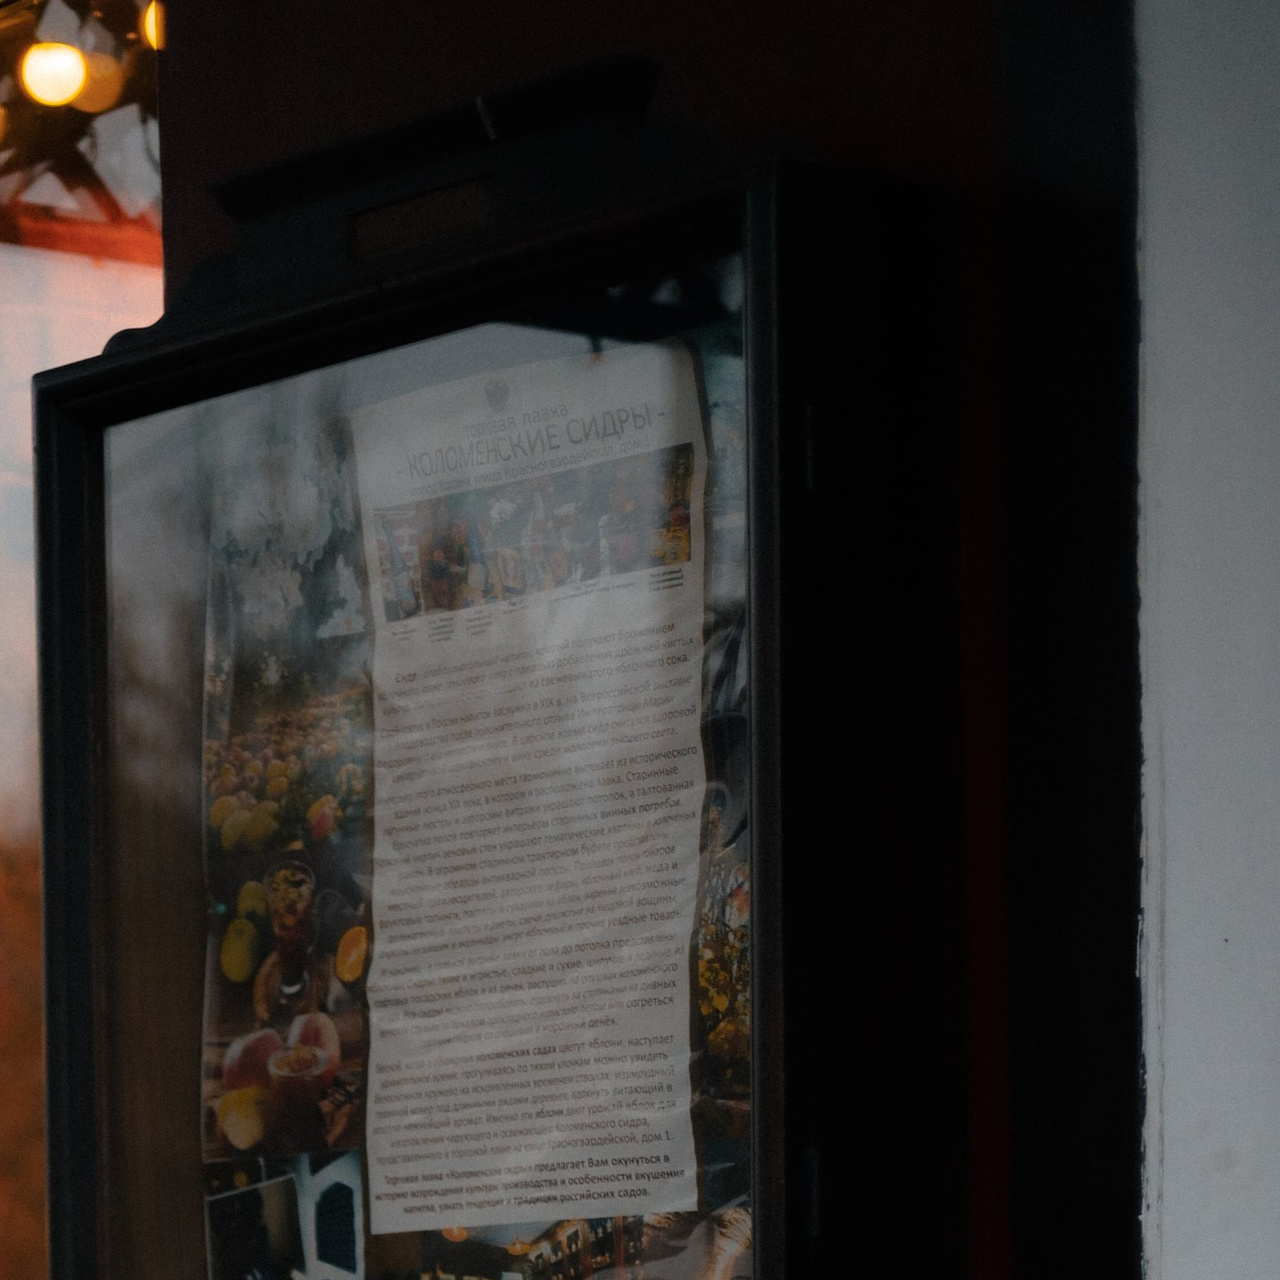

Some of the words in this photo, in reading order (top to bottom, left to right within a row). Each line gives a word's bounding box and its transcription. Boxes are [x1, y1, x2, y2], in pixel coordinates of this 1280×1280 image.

[522, 401, 569, 427] лавка
[406, 420, 561, 484] КОЛОМЕНСКИЕ
[565, 400, 652, 453] СИДРЫ
[629, 745, 697, 766] исторического
[626, 765, 679, 782] Старинные
[587, 790, 627, 805] потолок,
[637, 779, 694, 797] галтованная
[599, 805, 636, 819] винных
[574, 940, 610, 953] потолка
[640, 978, 676, 993] дивных
[626, 995, 673, 1009] согреться
[532, 1045, 556, 1057] садах
[627, 1034, 674, 1046] наступает
[629, 1050, 668, 1064] увидеть
[617, 1116, 649, 1129] сидра,
[534, 1160, 584, 1174] предлагает
[611, 1154, 660, 1167] окунуться
[568, 1172, 632, 1185] особенности
[634, 1168, 684, 1182] вкушения
[560, 1189, 614, 1204] российских
[617, 1187, 650, 1199] садов.
